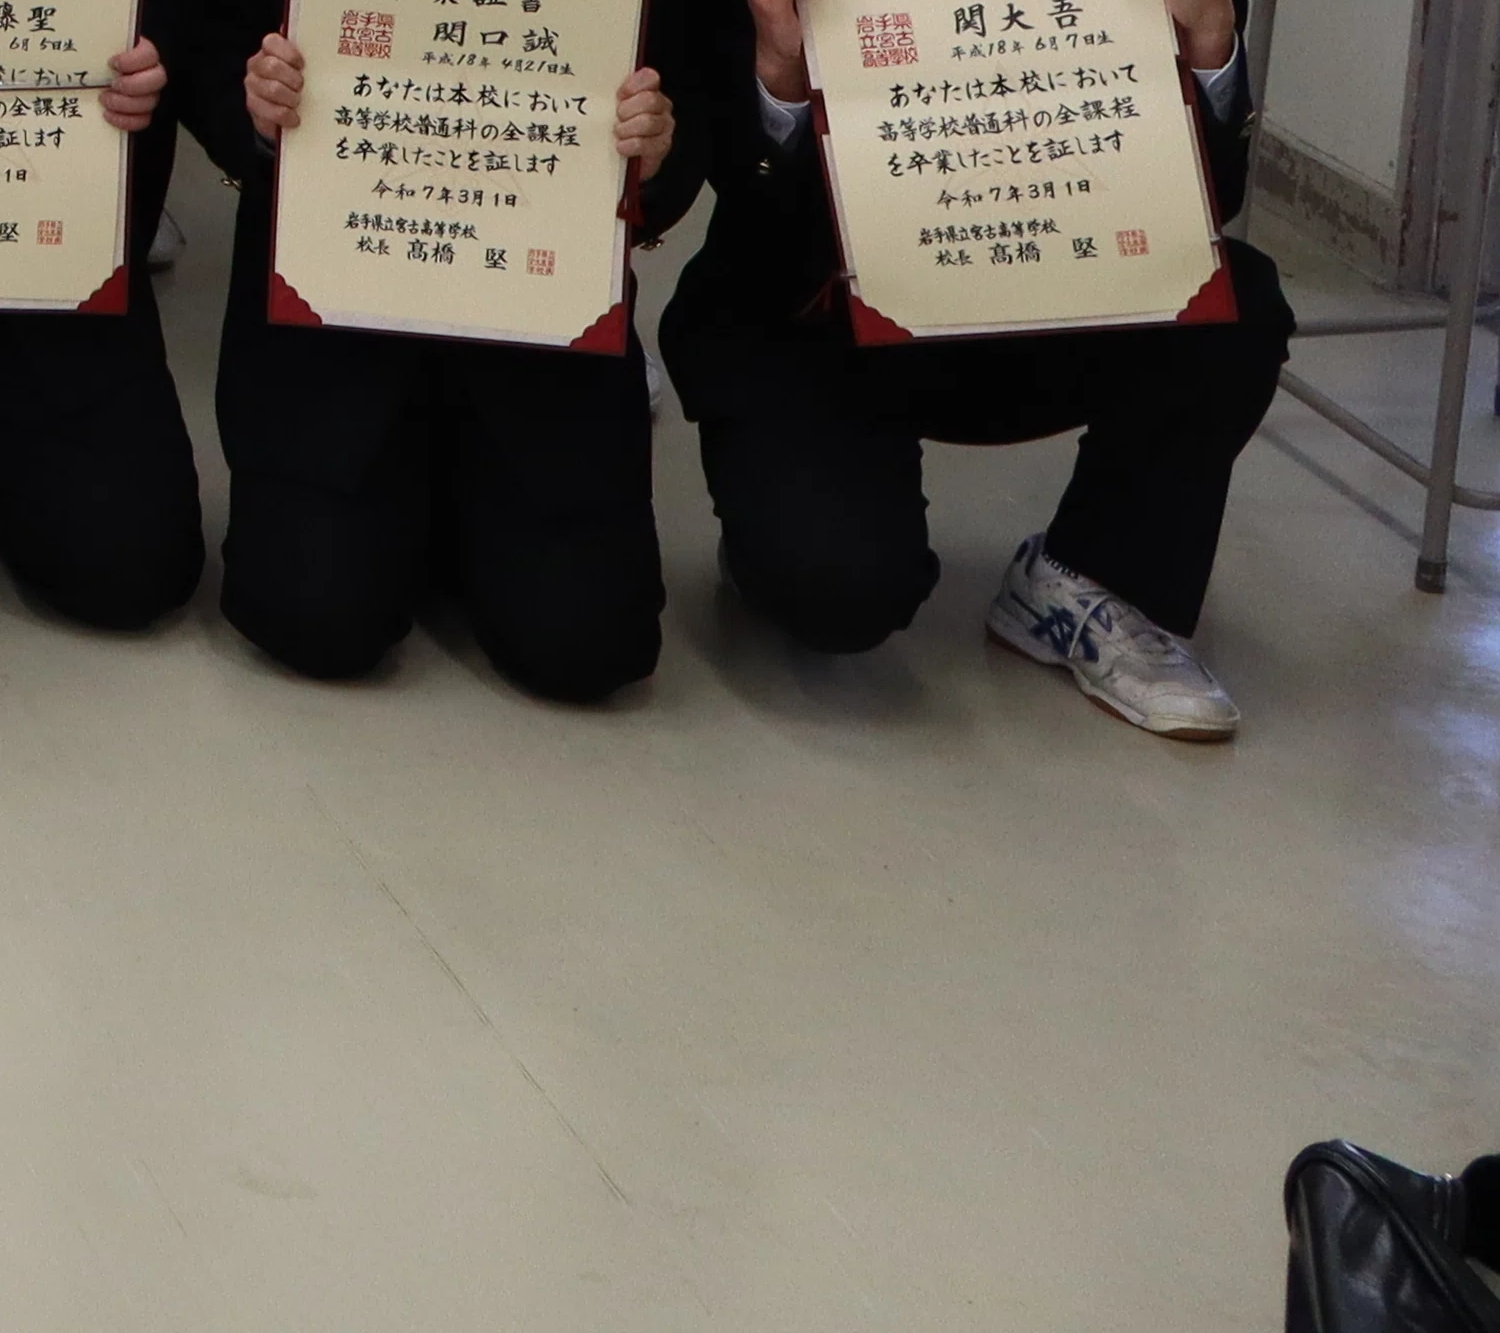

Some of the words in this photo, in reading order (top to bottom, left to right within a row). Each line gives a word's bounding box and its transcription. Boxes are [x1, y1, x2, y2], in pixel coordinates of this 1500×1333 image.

[434, 20, 560, 56] 関口誠
[353, 74, 588, 115] あなたは本校において
[889, 64, 1140, 108] あなたは本校において
[334, 136, 561, 176] を卒業したことを証します
[887, 130, 1126, 177] を卒業したことを証します
[372, 179, 518, 208] 令和7年3月1日
[937, 179, 1092, 207] 令和7年3月1日
